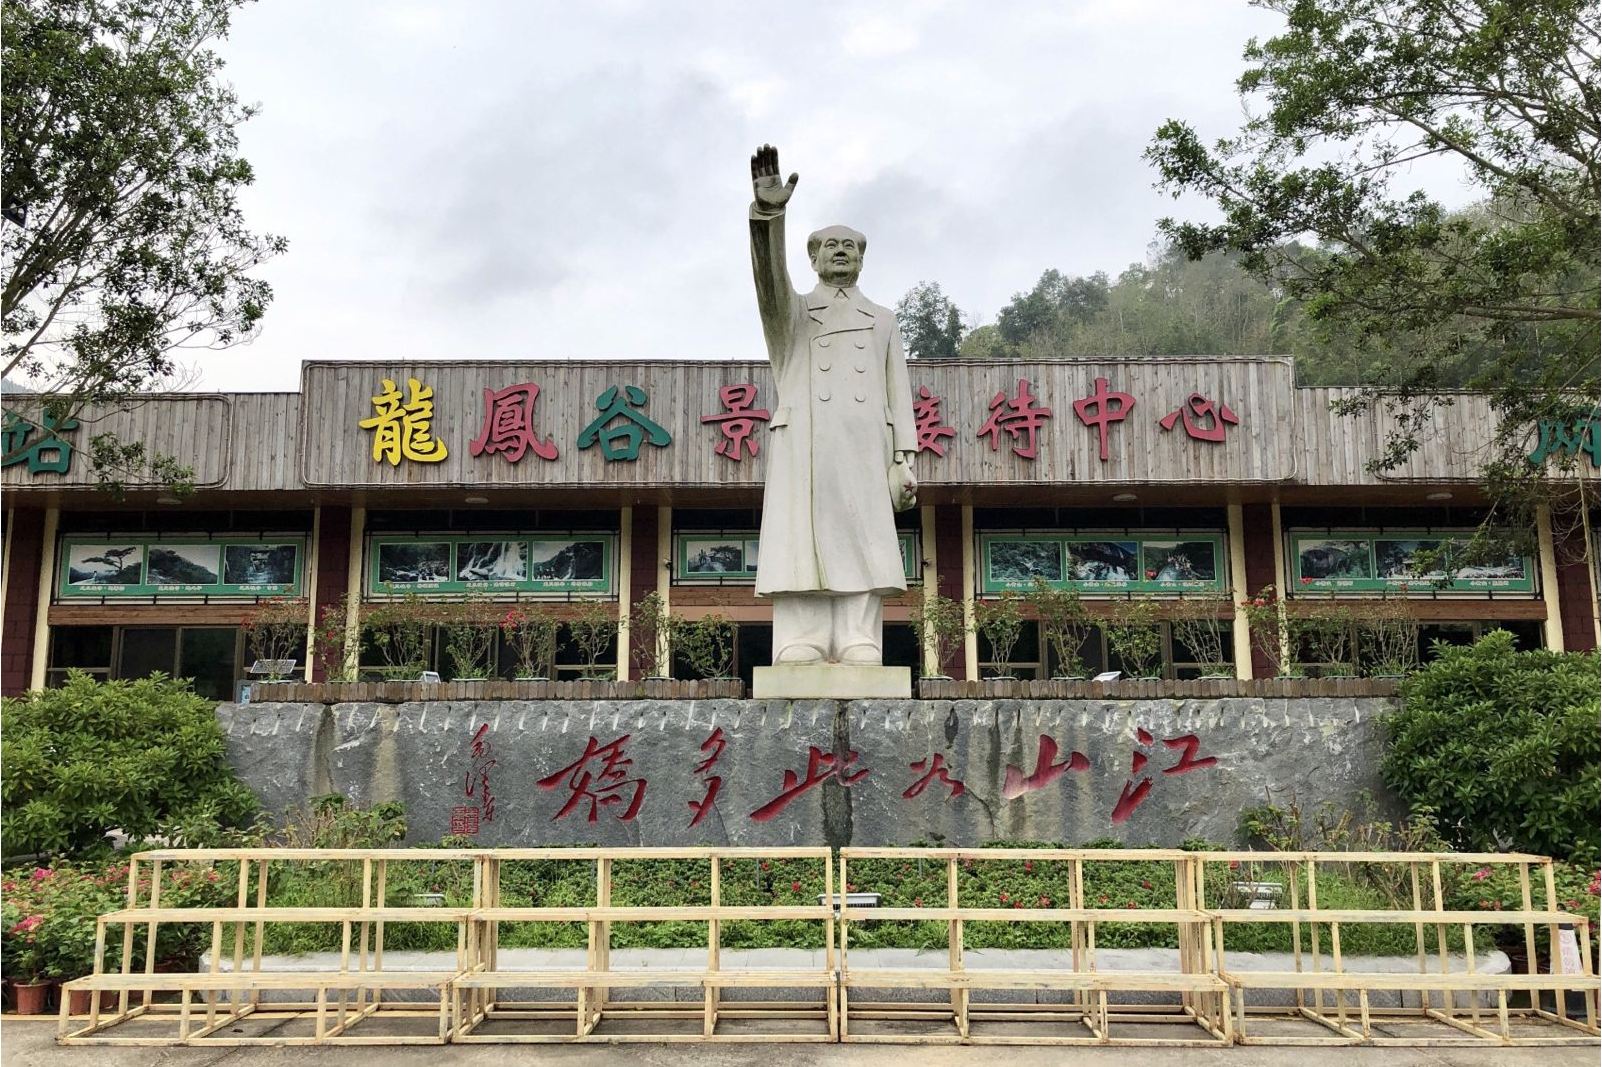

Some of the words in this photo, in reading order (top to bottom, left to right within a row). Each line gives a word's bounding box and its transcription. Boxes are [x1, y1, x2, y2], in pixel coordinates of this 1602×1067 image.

[357, 377, 1239, 466] 龍鳳谷景接待中心
